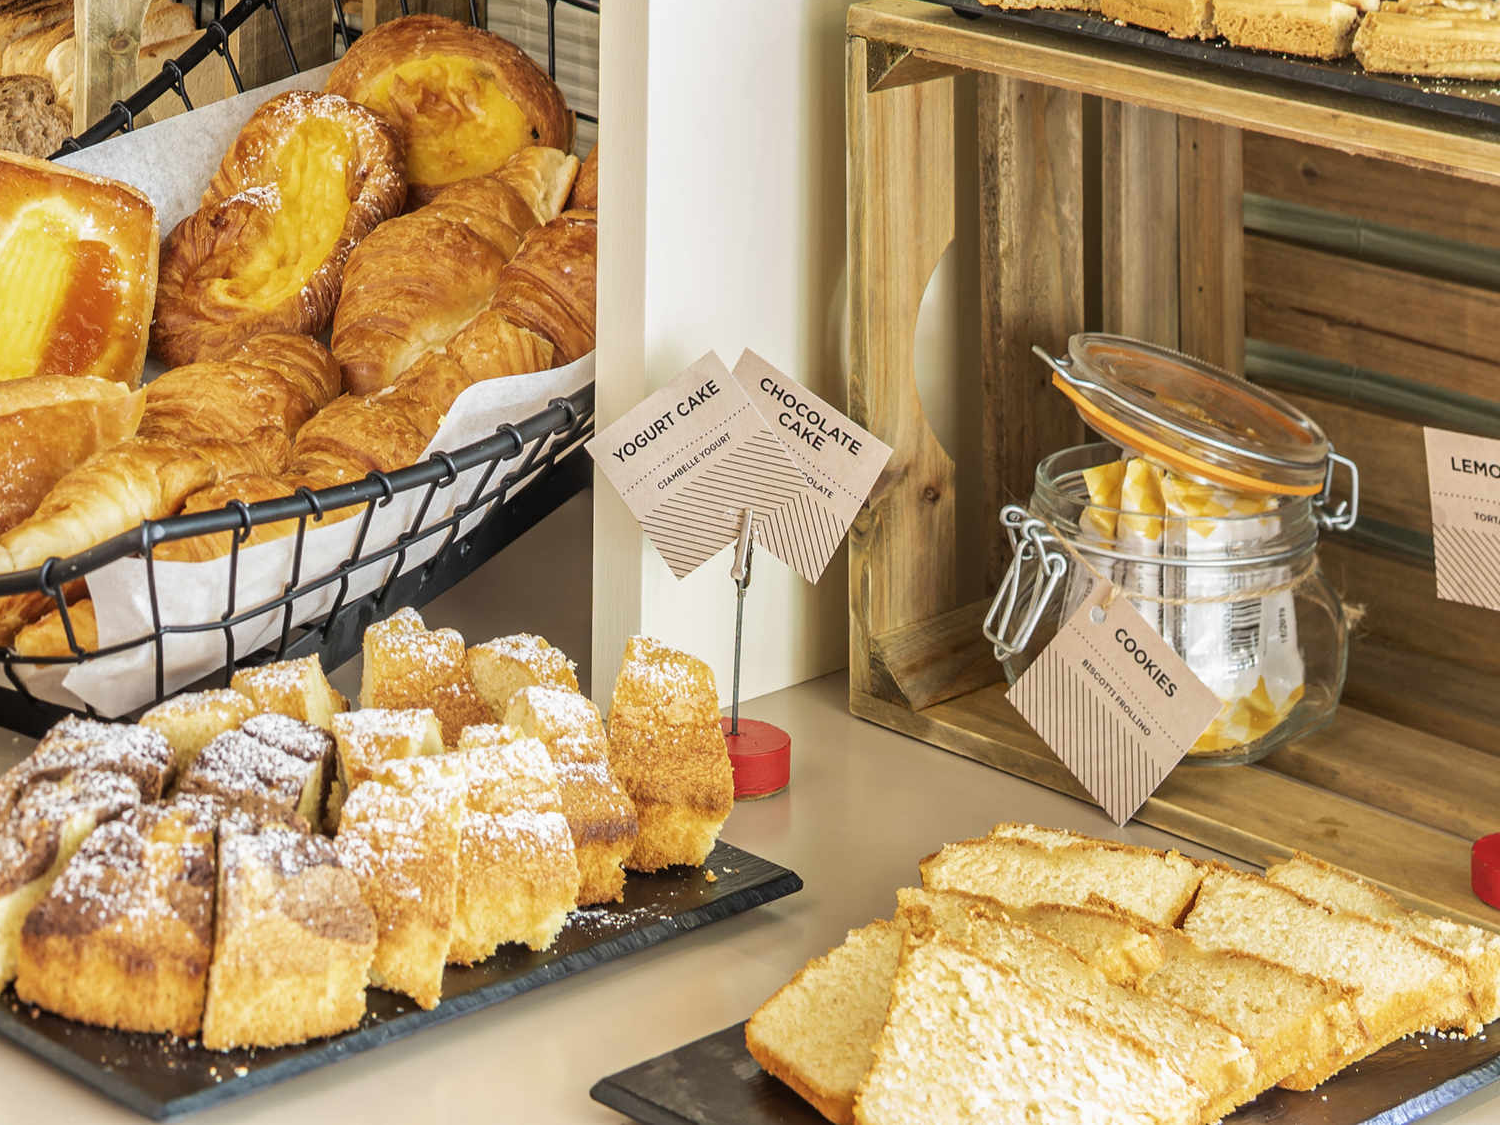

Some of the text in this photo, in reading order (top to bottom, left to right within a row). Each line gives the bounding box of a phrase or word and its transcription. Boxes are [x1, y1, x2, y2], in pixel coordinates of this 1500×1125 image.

[612, 379, 721, 465] YOGURT CAKE
[759, 377, 863, 456] CHOCOLATE
[778, 412, 826, 452] CAKE
[657, 431, 732, 491] CIAMBELLE YOGURT
[1081, 658, 1151, 736] BISCOTTI FROLLINO
[1115, 628, 1178, 698] COOKIES
